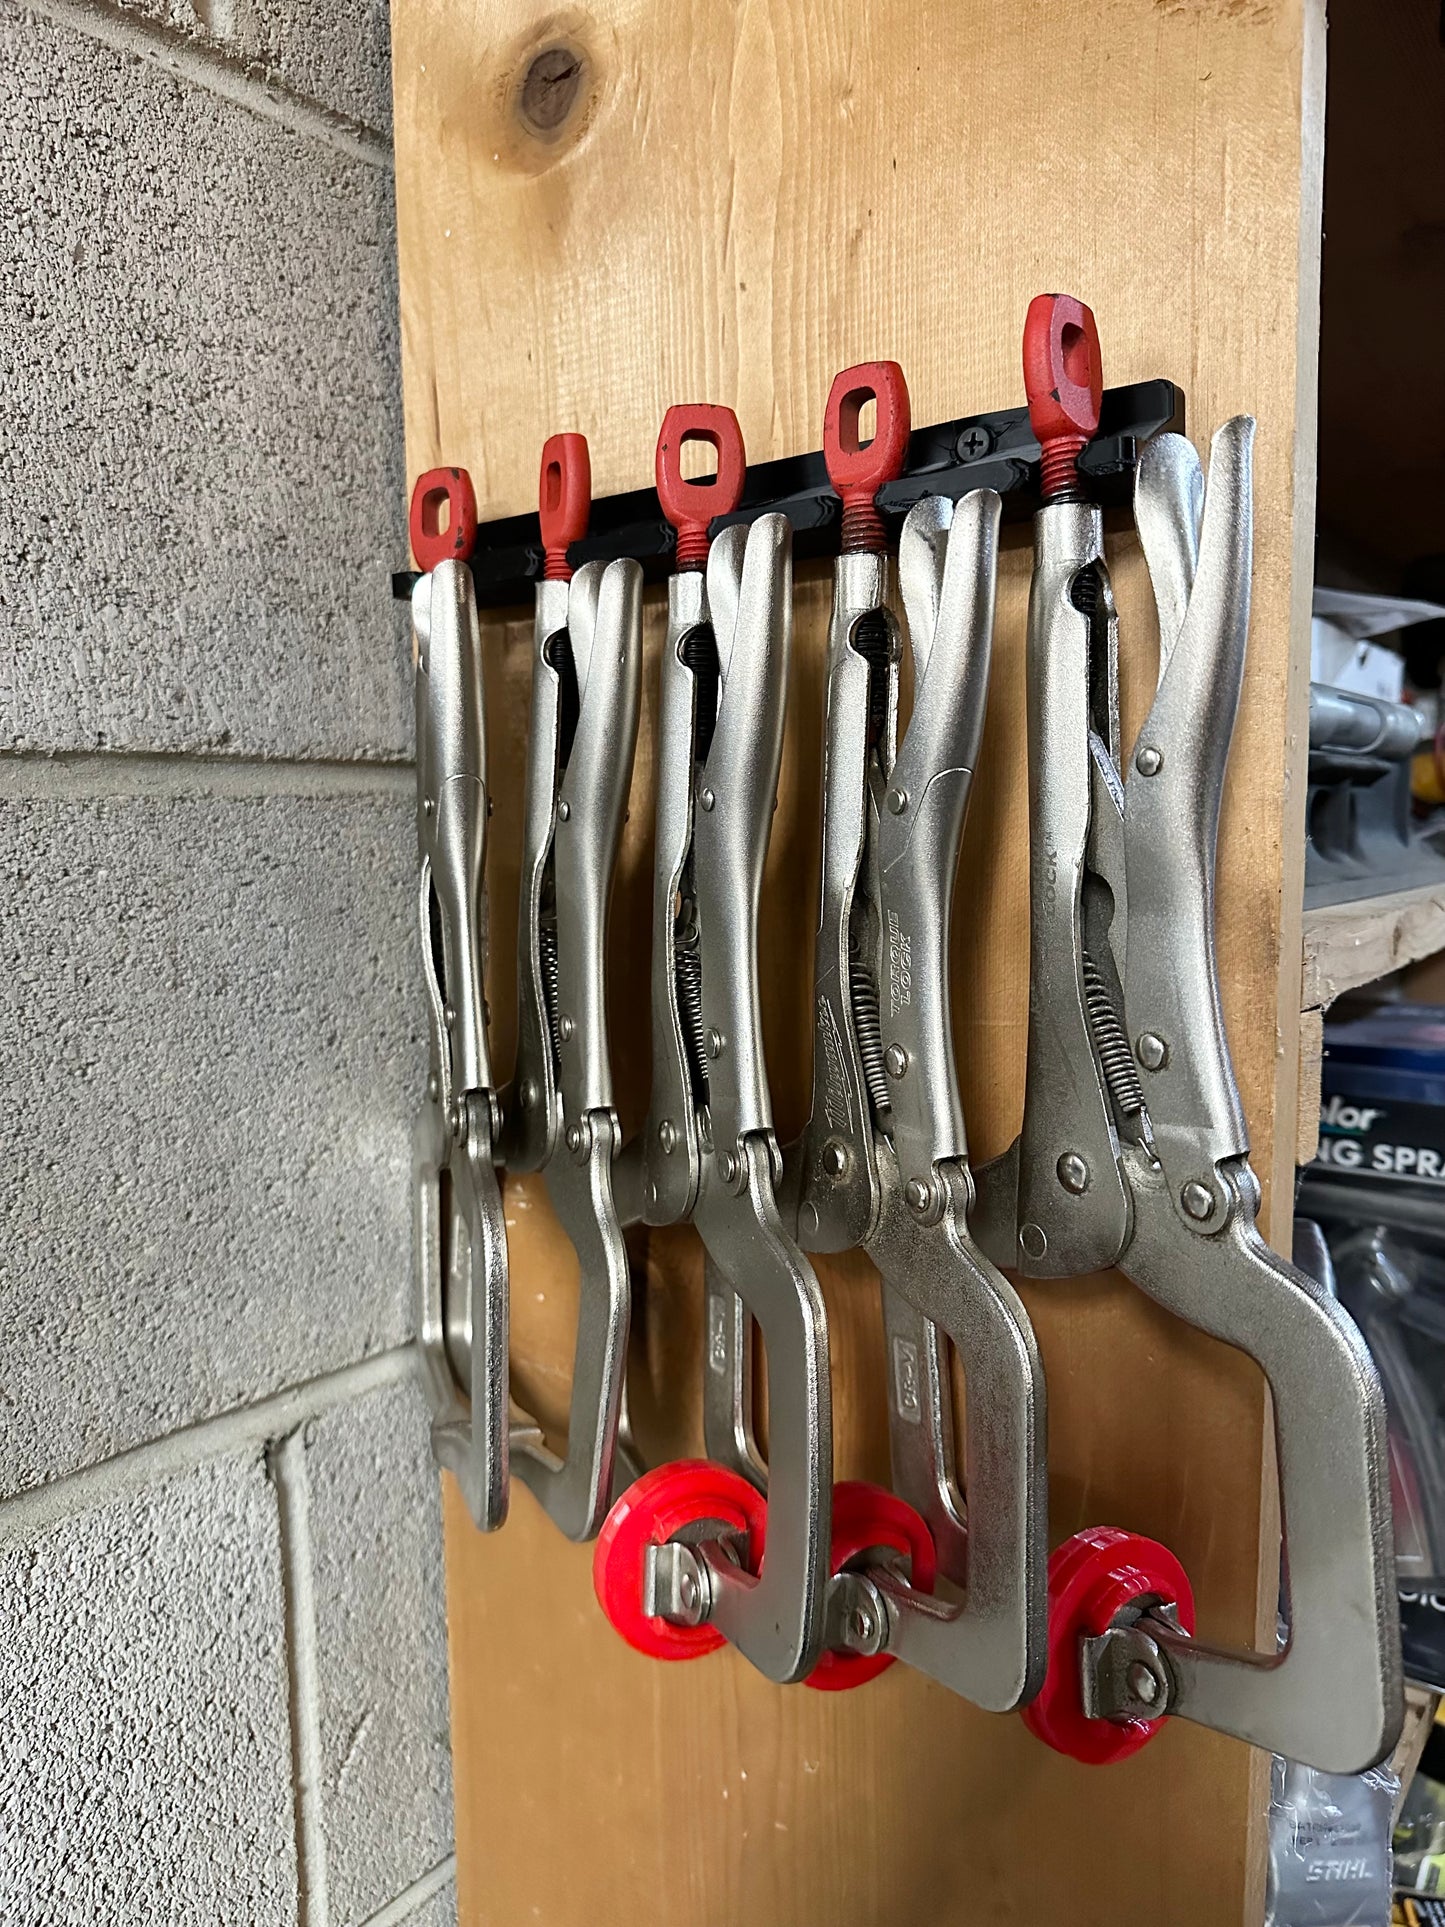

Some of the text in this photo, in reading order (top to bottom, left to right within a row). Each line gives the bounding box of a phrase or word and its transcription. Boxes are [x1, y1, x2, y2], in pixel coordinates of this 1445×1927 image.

[887, 909, 901, 1018] TORQUE
[900, 931, 911, 1005] LOCK
[817, 994, 847, 1129] Milwaukee
[1306, 1858, 1373, 1882] STIHL
